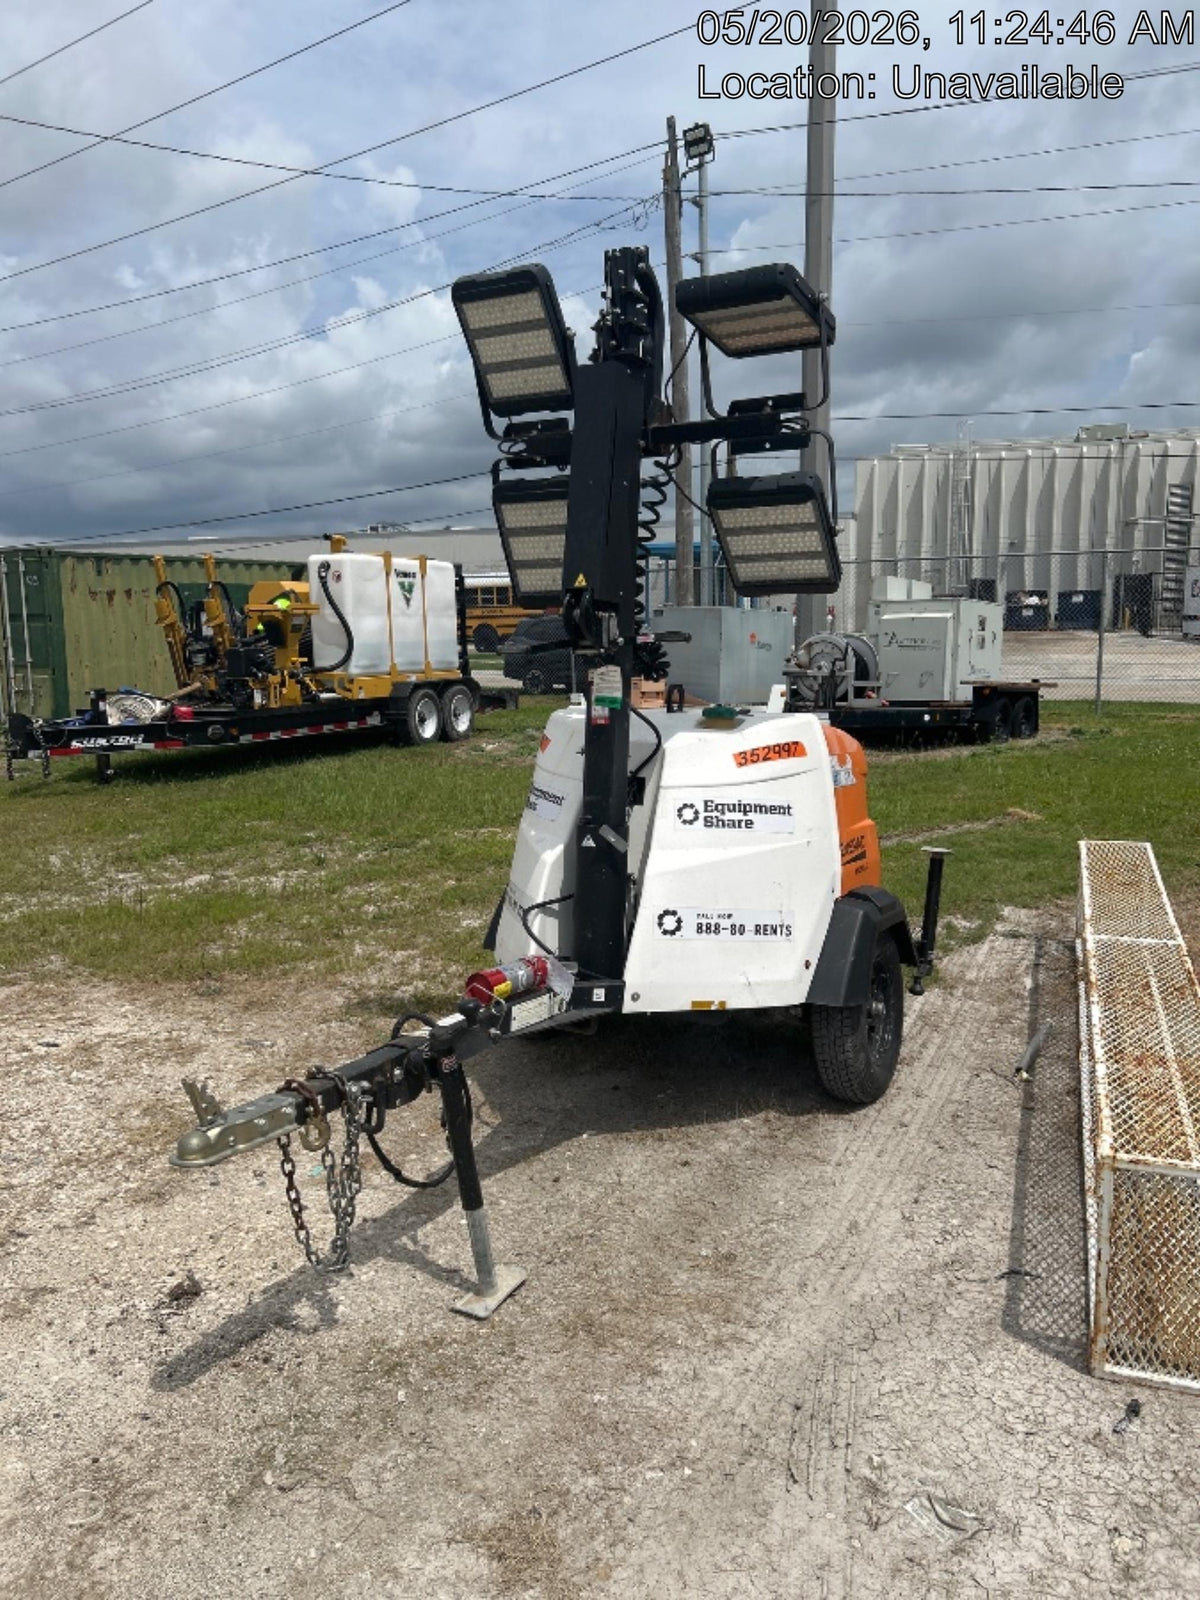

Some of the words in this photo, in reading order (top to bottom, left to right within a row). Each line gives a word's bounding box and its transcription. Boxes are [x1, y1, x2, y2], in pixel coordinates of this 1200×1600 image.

[738, 741, 800, 767] 352997
[703, 799, 793, 817] Equipment
[703, 816, 755, 829] Share
[696, 923, 792, 938] 888-80-RENTS
